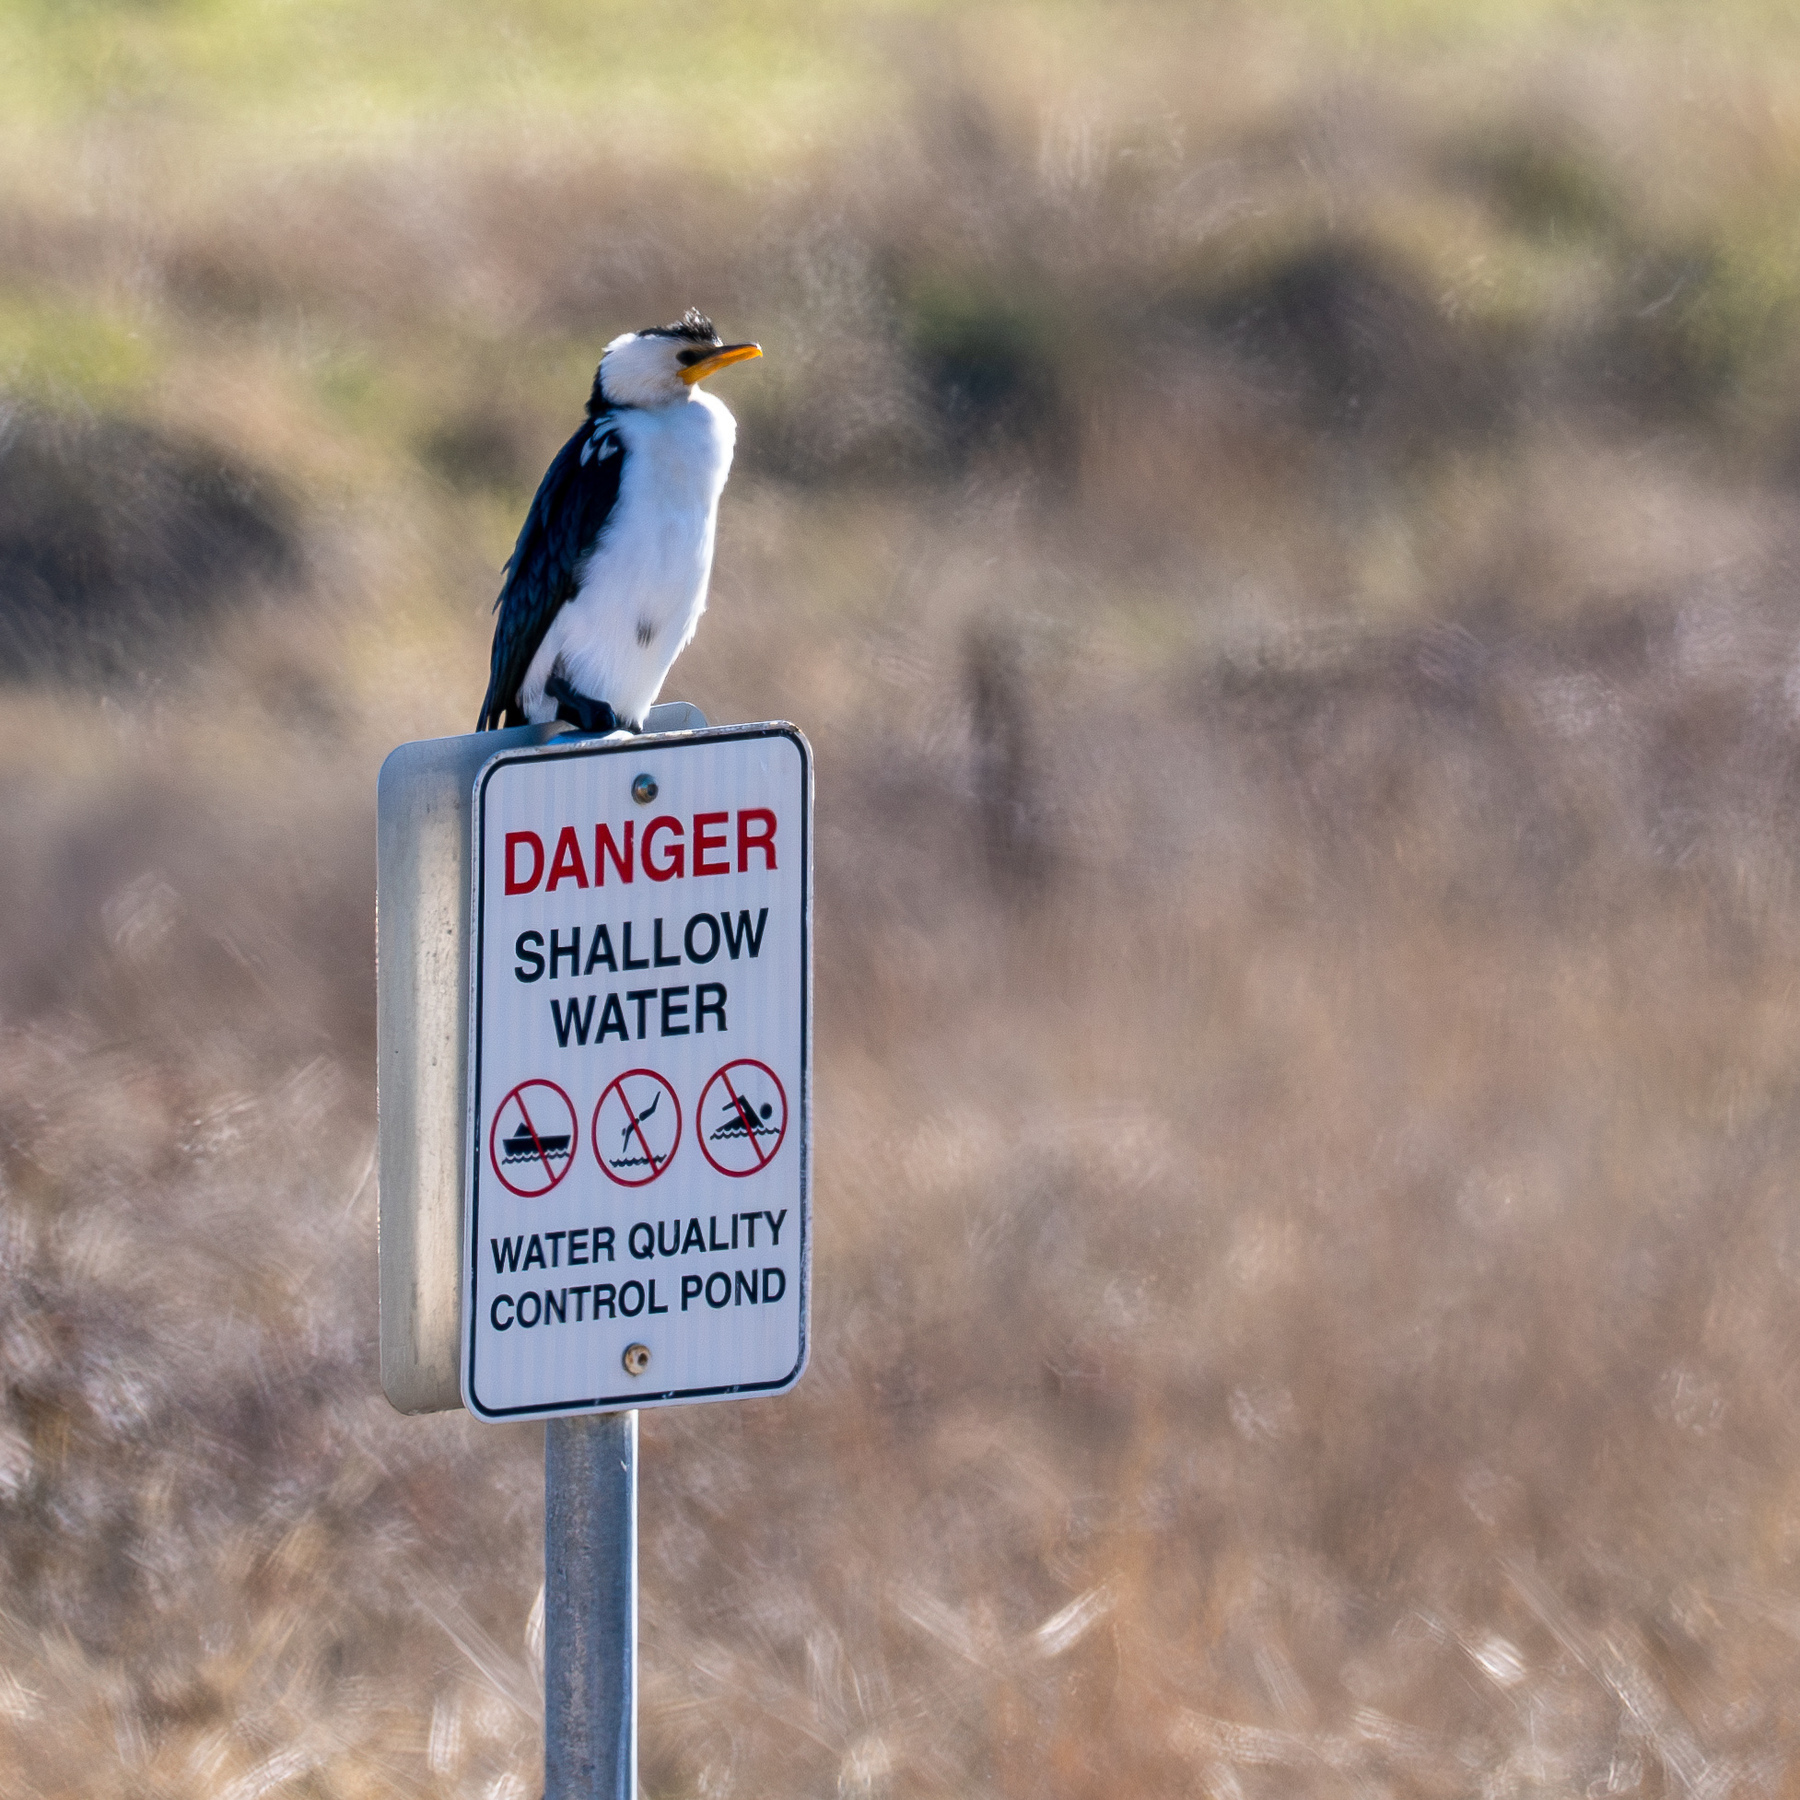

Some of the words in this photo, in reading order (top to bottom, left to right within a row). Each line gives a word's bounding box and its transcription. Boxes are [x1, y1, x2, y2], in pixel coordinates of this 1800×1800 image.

[504, 807, 778, 896] DANGER
[514, 907, 769, 983] SHALLOW
[550, 982, 729, 1048] WATER
[490, 1226, 616, 1274] WATER
[628, 1209, 787, 1260] QUALITY
[490, 1280, 669, 1332] CONTROL
[681, 1267, 787, 1312] POND
